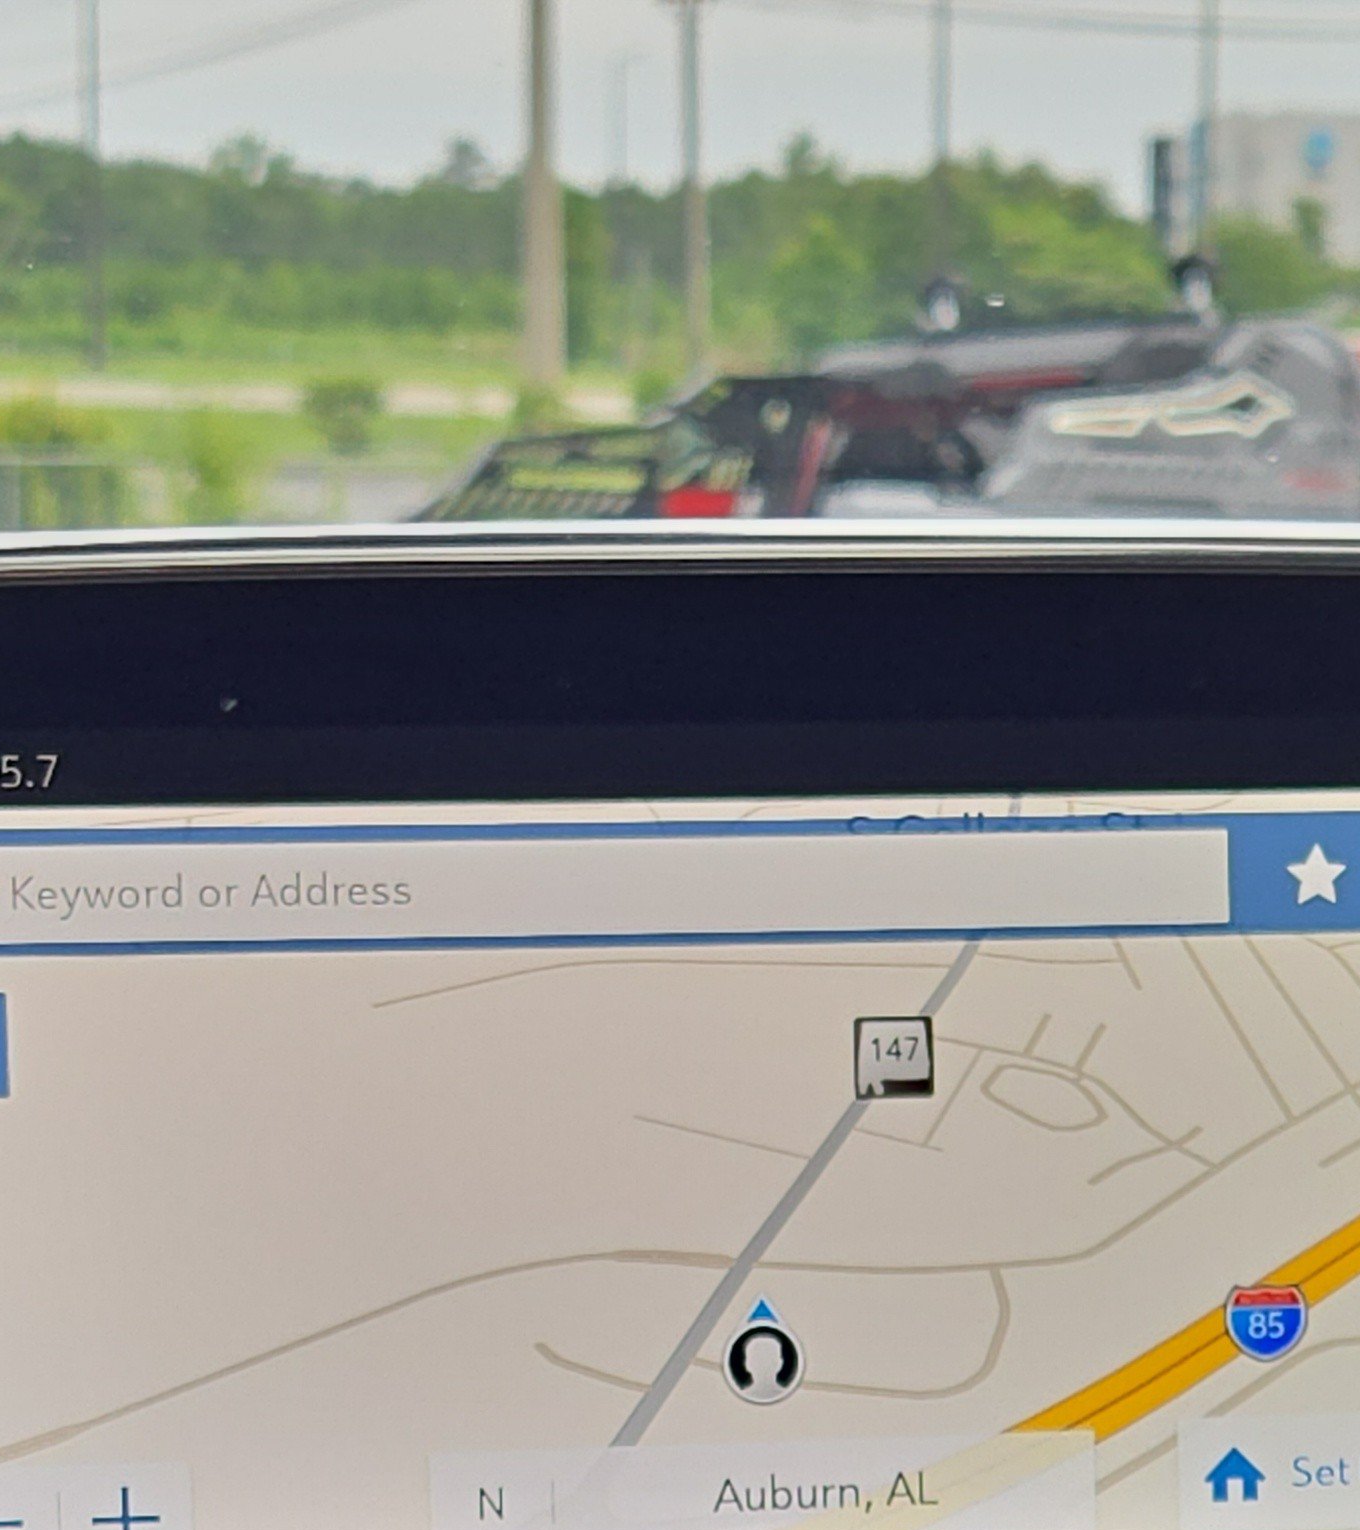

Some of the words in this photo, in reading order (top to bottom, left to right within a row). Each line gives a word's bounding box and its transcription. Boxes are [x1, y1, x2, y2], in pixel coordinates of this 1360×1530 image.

[10, 872, 184, 922] Keyword
[198, 884, 239, 909] or
[250, 871, 413, 908] Address
[871, 1036, 919, 1061] 147
[1248, 1311, 1286, 1340] 85
[1291, 1456, 1351, 1488] Set
[478, 1486, 504, 1521] N
[713, 1473, 873, 1513] Auburn,
[886, 1470, 940, 1506] AL
